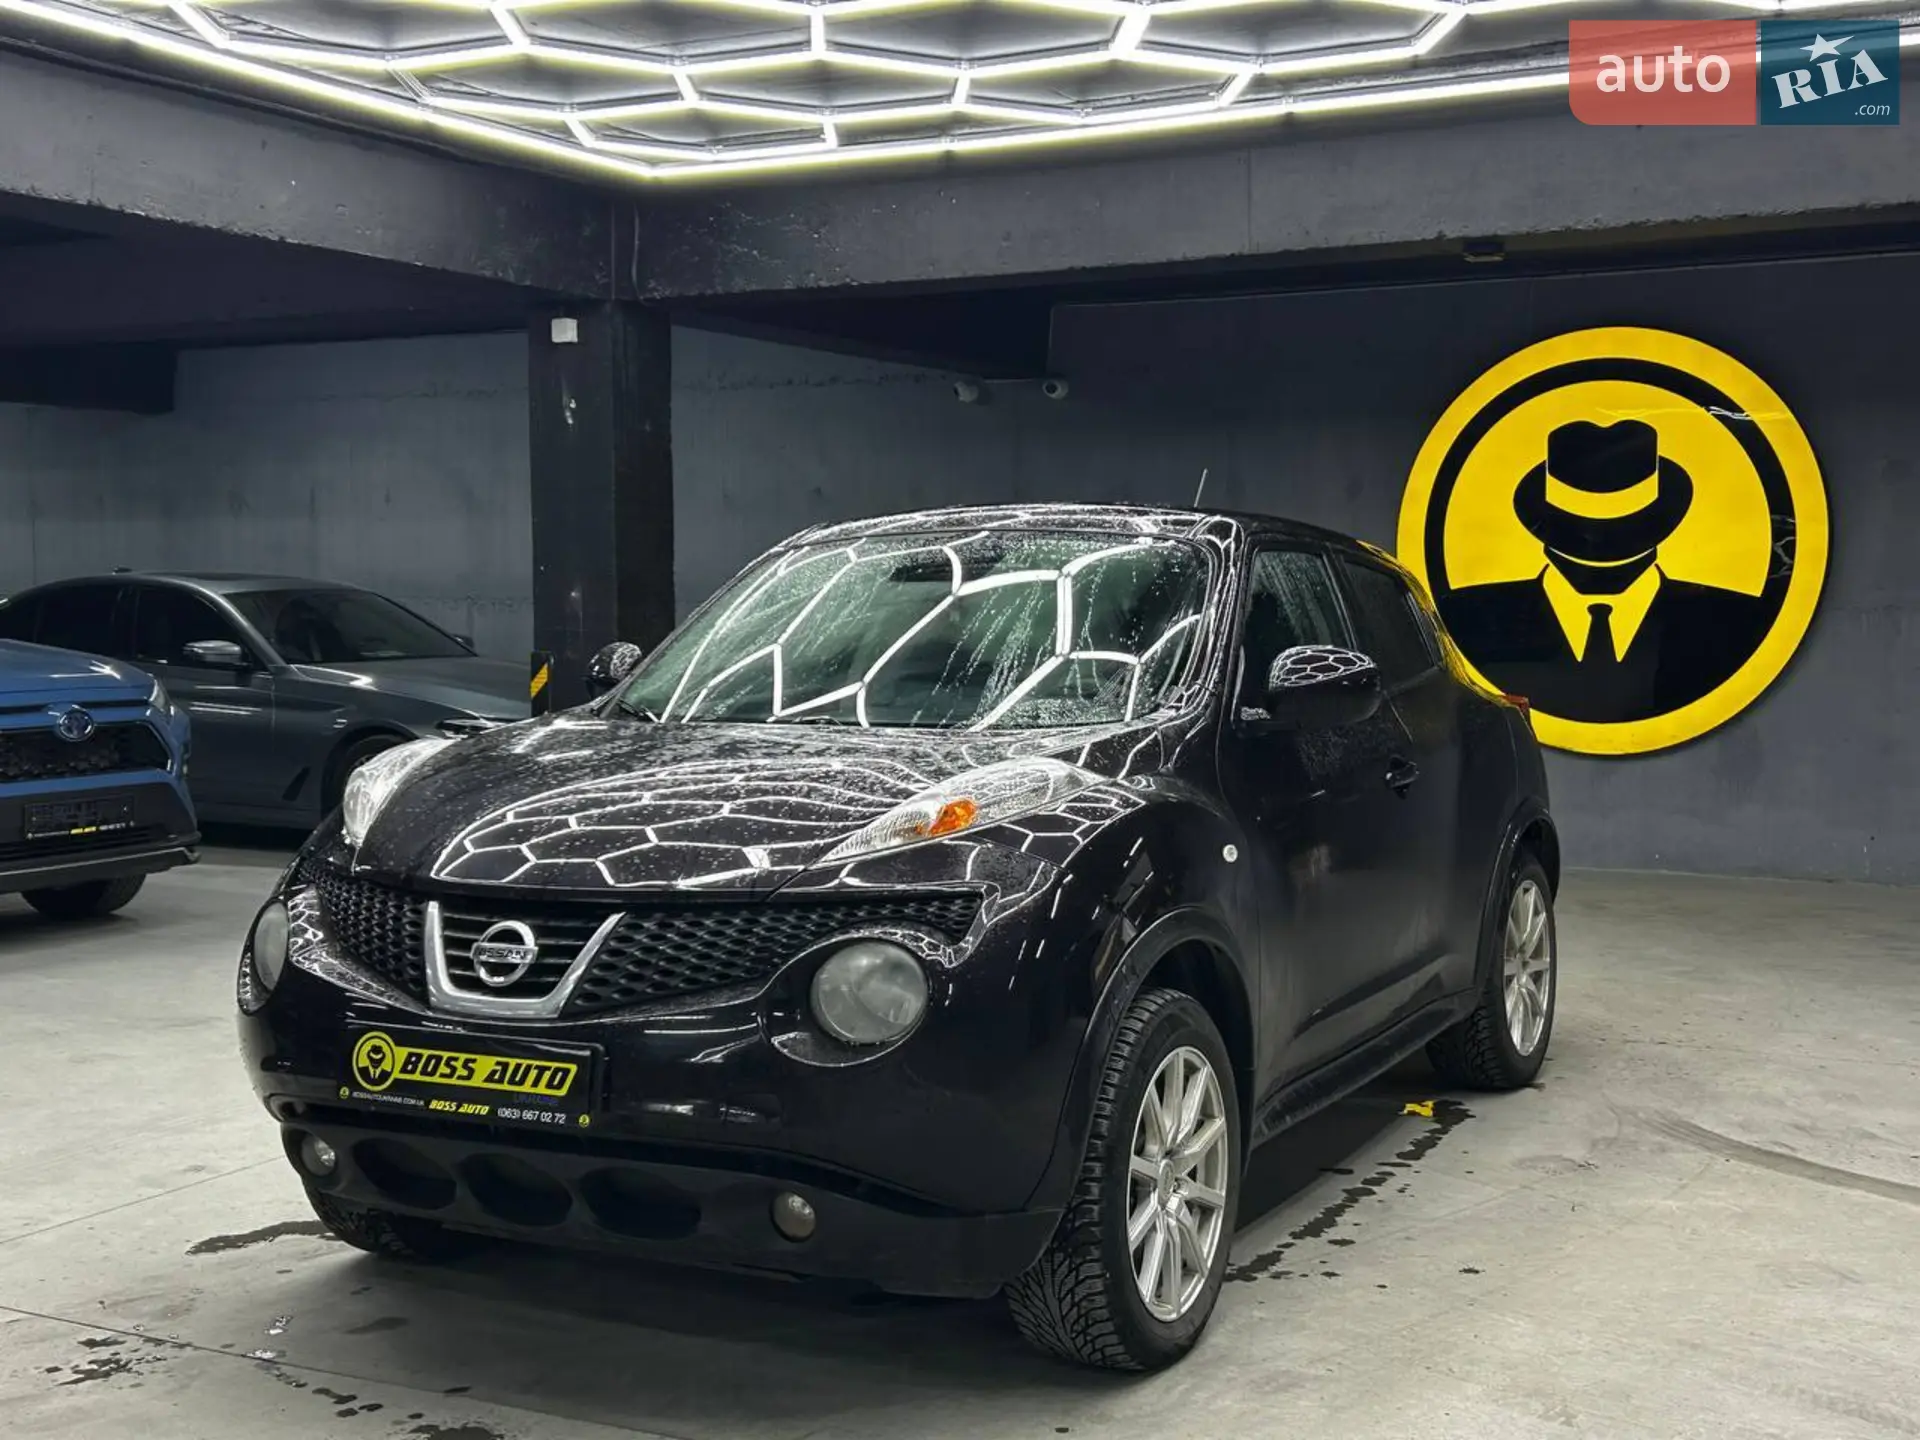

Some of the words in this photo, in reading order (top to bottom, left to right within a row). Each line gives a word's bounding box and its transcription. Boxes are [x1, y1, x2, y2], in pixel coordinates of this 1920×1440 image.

[399, 1052, 477, 1081] BOSS
[482, 1061, 571, 1090] AUTO
[429, 1099, 457, 1111] BOSS
[458, 1103, 490, 1116] AUTO
[522, 1109, 540, 1121] 667
[540, 1112, 553, 1123] 02
[553, 1114, 567, 1124] 72
